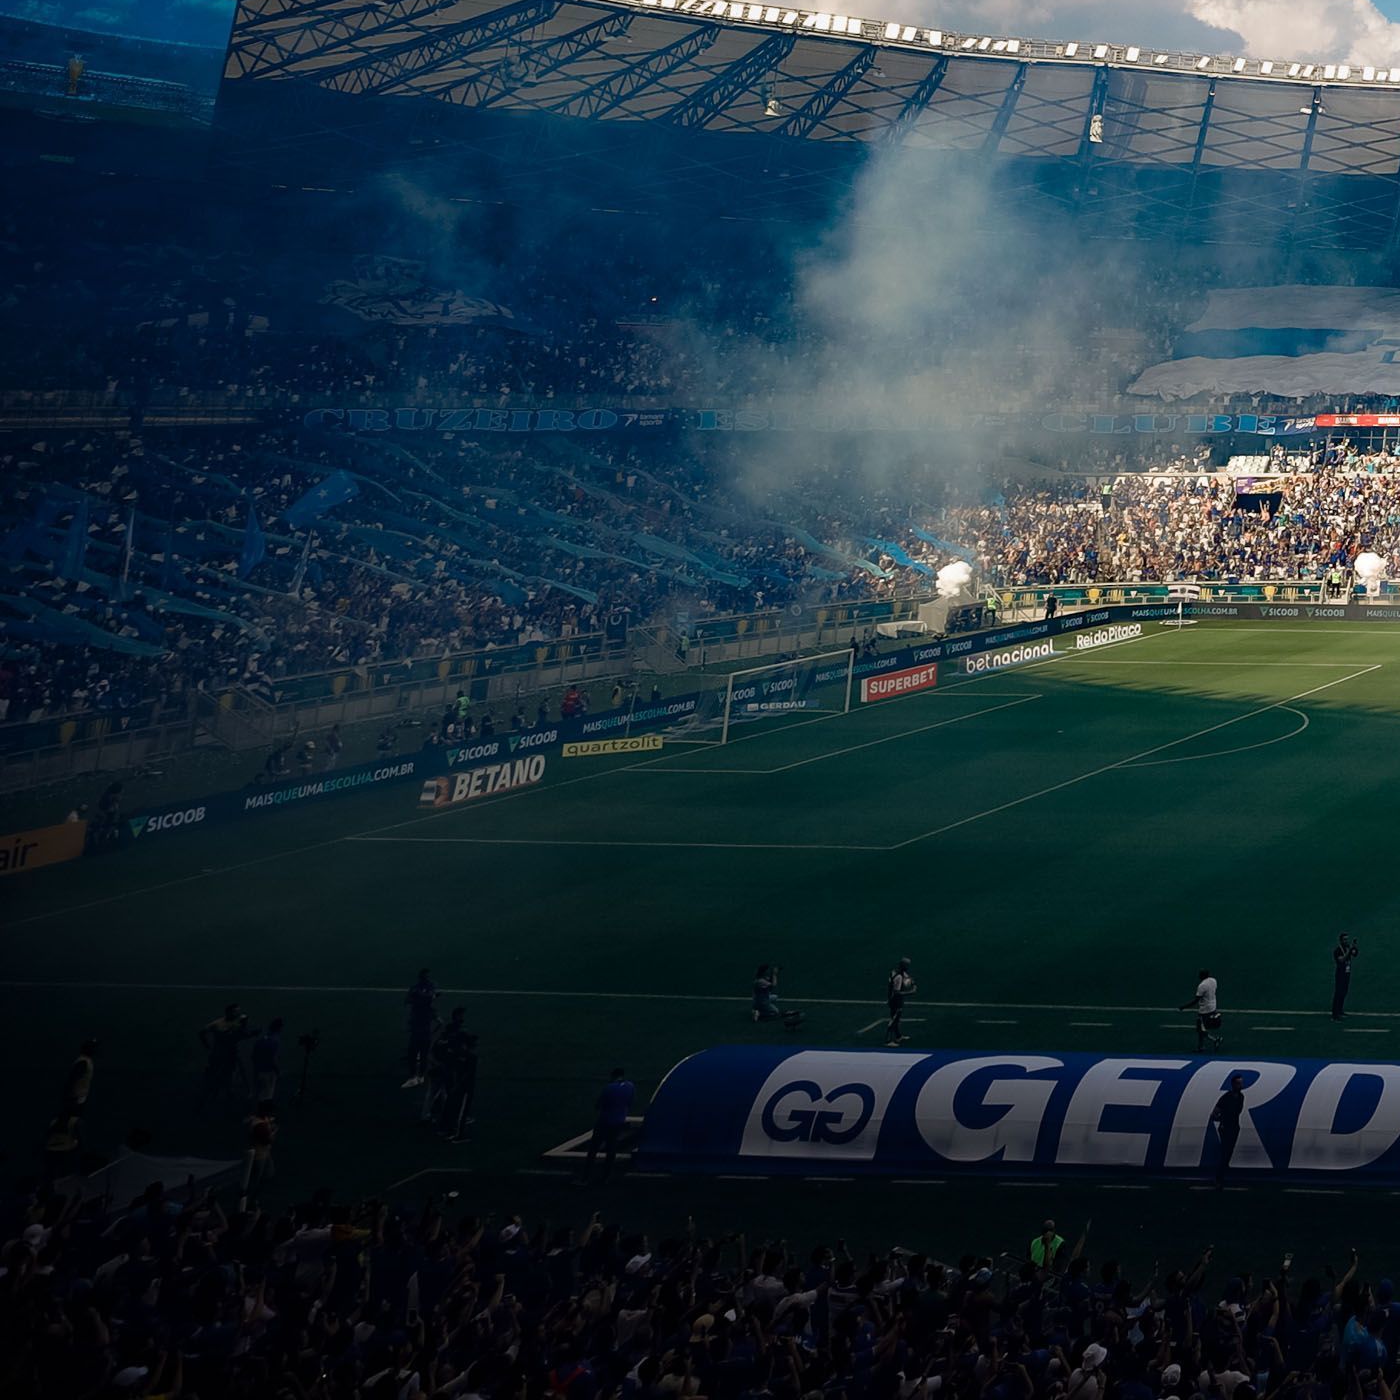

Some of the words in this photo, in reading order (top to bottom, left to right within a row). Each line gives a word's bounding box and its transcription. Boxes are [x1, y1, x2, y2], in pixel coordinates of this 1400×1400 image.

[303, 407, 619, 432] CRUZEIRO
[1041, 413, 1277, 436] CLUBE
[1269, 607, 1299, 617] SICOOB
[1314, 607, 1345, 617] SICOOB
[868, 666, 936, 695] SUPERBET
[760, 701, 807, 711] GERDAU
[519, 729, 558, 751] SICOOB
[566, 736, 661, 756] quartzolit
[456, 742, 499, 764] SICOOB
[243, 761, 415, 810] MAISQUEUMAESCOLHA.COM.BR
[451, 754, 546, 802] BETANO
[145, 805, 207, 834] SICOOB
